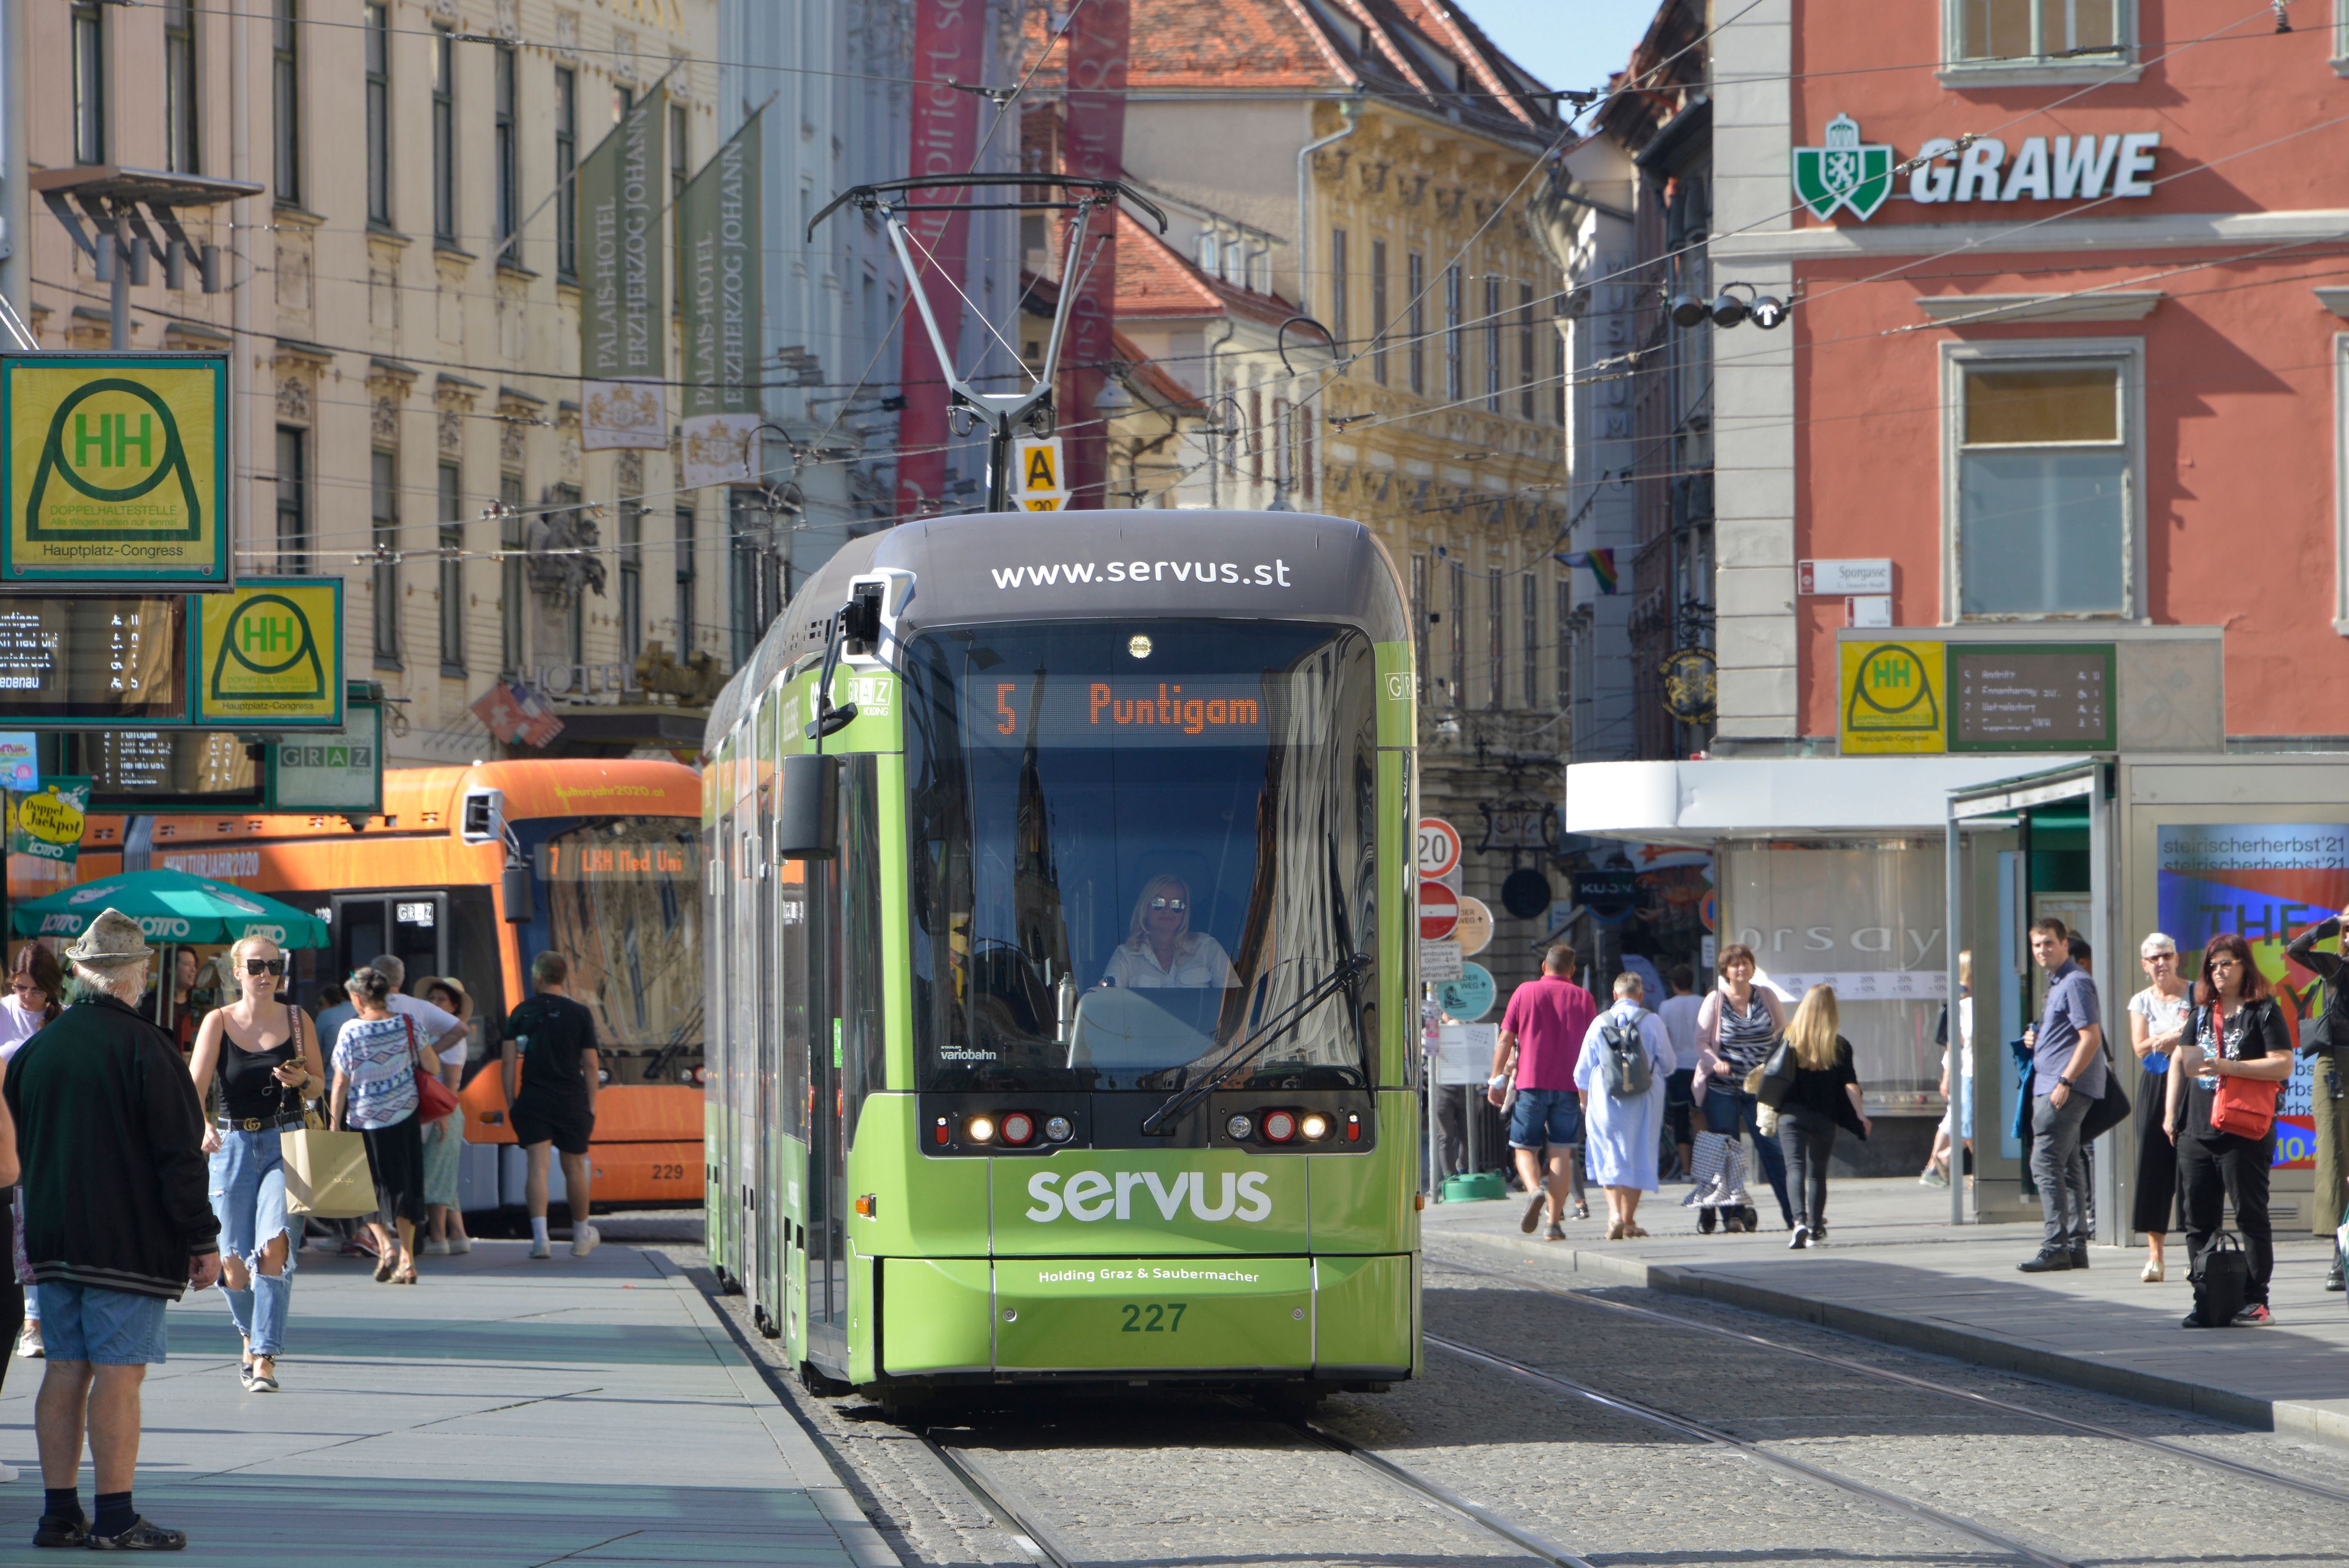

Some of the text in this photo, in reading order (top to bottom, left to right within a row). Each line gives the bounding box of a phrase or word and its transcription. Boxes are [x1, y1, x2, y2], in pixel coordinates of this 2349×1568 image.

[935, 0, 964, 30] s
[1909, 132, 2161, 204] GRAWE
[624, 108, 650, 368] ERZHERZOG JOHANN
[595, 197, 618, 368] PALAIS-HOTEL
[720, 140, 747, 405] ERZHERZOG JOHANN
[694, 231, 716, 407] PALAIS-HOTEL
[75, 413, 151, 467] HH
[1027, 450, 1055, 487] A
[50, 506, 177, 516] DOPPELHALTESTELLE
[70, 518, 99, 527] Wagen
[43, 544, 183, 558] Hauptplatz-Congress
[992, 558, 1291, 590] www.servus.st
[1839, 566, 1886, 580] Sporgasse
[244, 617, 292, 652] HH
[517, 664, 644, 695] HOTEL
[1873, 659, 1910, 688] HH
[849, 678, 893, 705] GRAZ
[223, 702, 314, 711] Hauptplatz-Congress
[863, 706, 890, 716] HOLDING
[997, 682, 1259, 735] 5 Puntigam
[281, 747, 370, 766] GRAZ
[26, 800, 63, 816] Doppel
[26, 812, 80, 835] Jackpot
[28, 842, 64, 858] LOTTO
[1419, 835, 1446, 863] 20
[2163, 836, 2344, 853] steirischerherbst'21
[549, 847, 560, 874] 7
[581, 849, 613, 872] LKH
[657, 849, 682, 872] Uni
[40, 914, 82, 933] LOTTO
[398, 904, 433, 921] GRZ
[2199, 904, 2309, 946] THE
[1738, 925, 1942, 972] orsay
[294, 1027, 302, 1051] MARC
[941, 1049, 997, 1060] variobahn
[652, 1164, 684, 1180] 229
[1025, 1170, 1272, 1223] servus
[1039, 1267, 1260, 1284] Holding Graz & Saubermacher
[1121, 1303, 1188, 1332] 227
